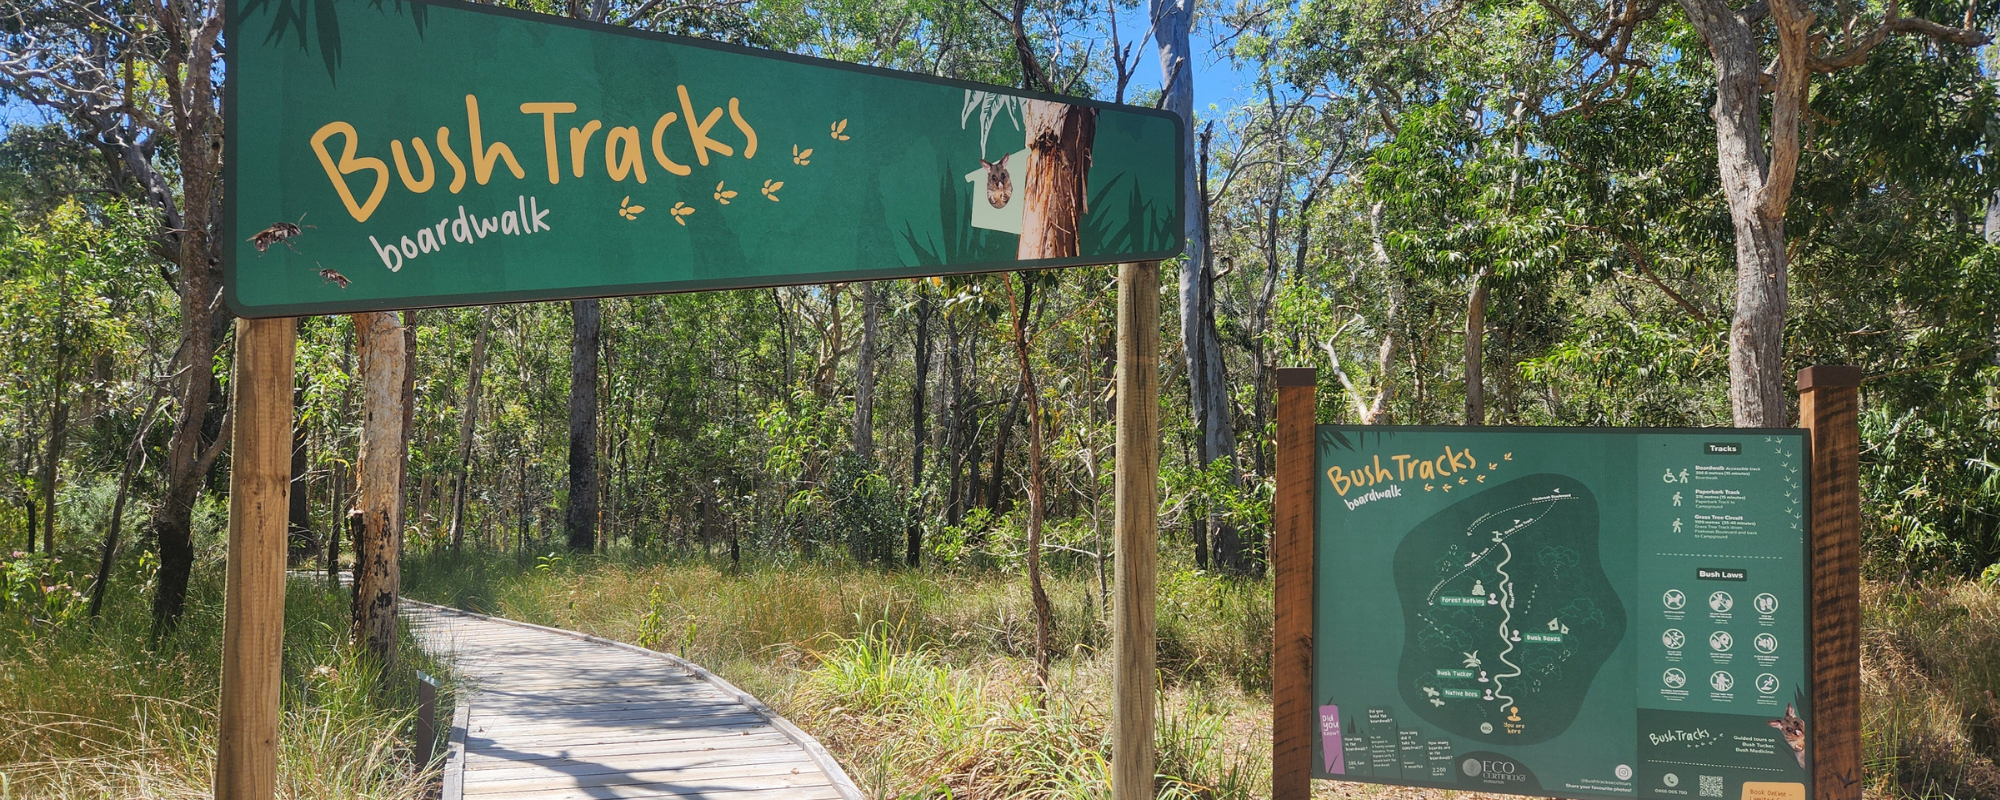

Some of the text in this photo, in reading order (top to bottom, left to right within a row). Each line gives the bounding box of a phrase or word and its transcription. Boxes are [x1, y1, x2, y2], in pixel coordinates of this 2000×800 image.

[369, 195, 551, 272] boardwalk
[1344, 484, 1402, 511] boardwalk
[1699, 570, 1743, 579] Bush Laws
[1462, 597, 1485, 606] Bathing
[1322, 714, 1335, 722] Did
[1323, 722, 1340, 732] you
[1483, 760, 1515, 774] ECO
